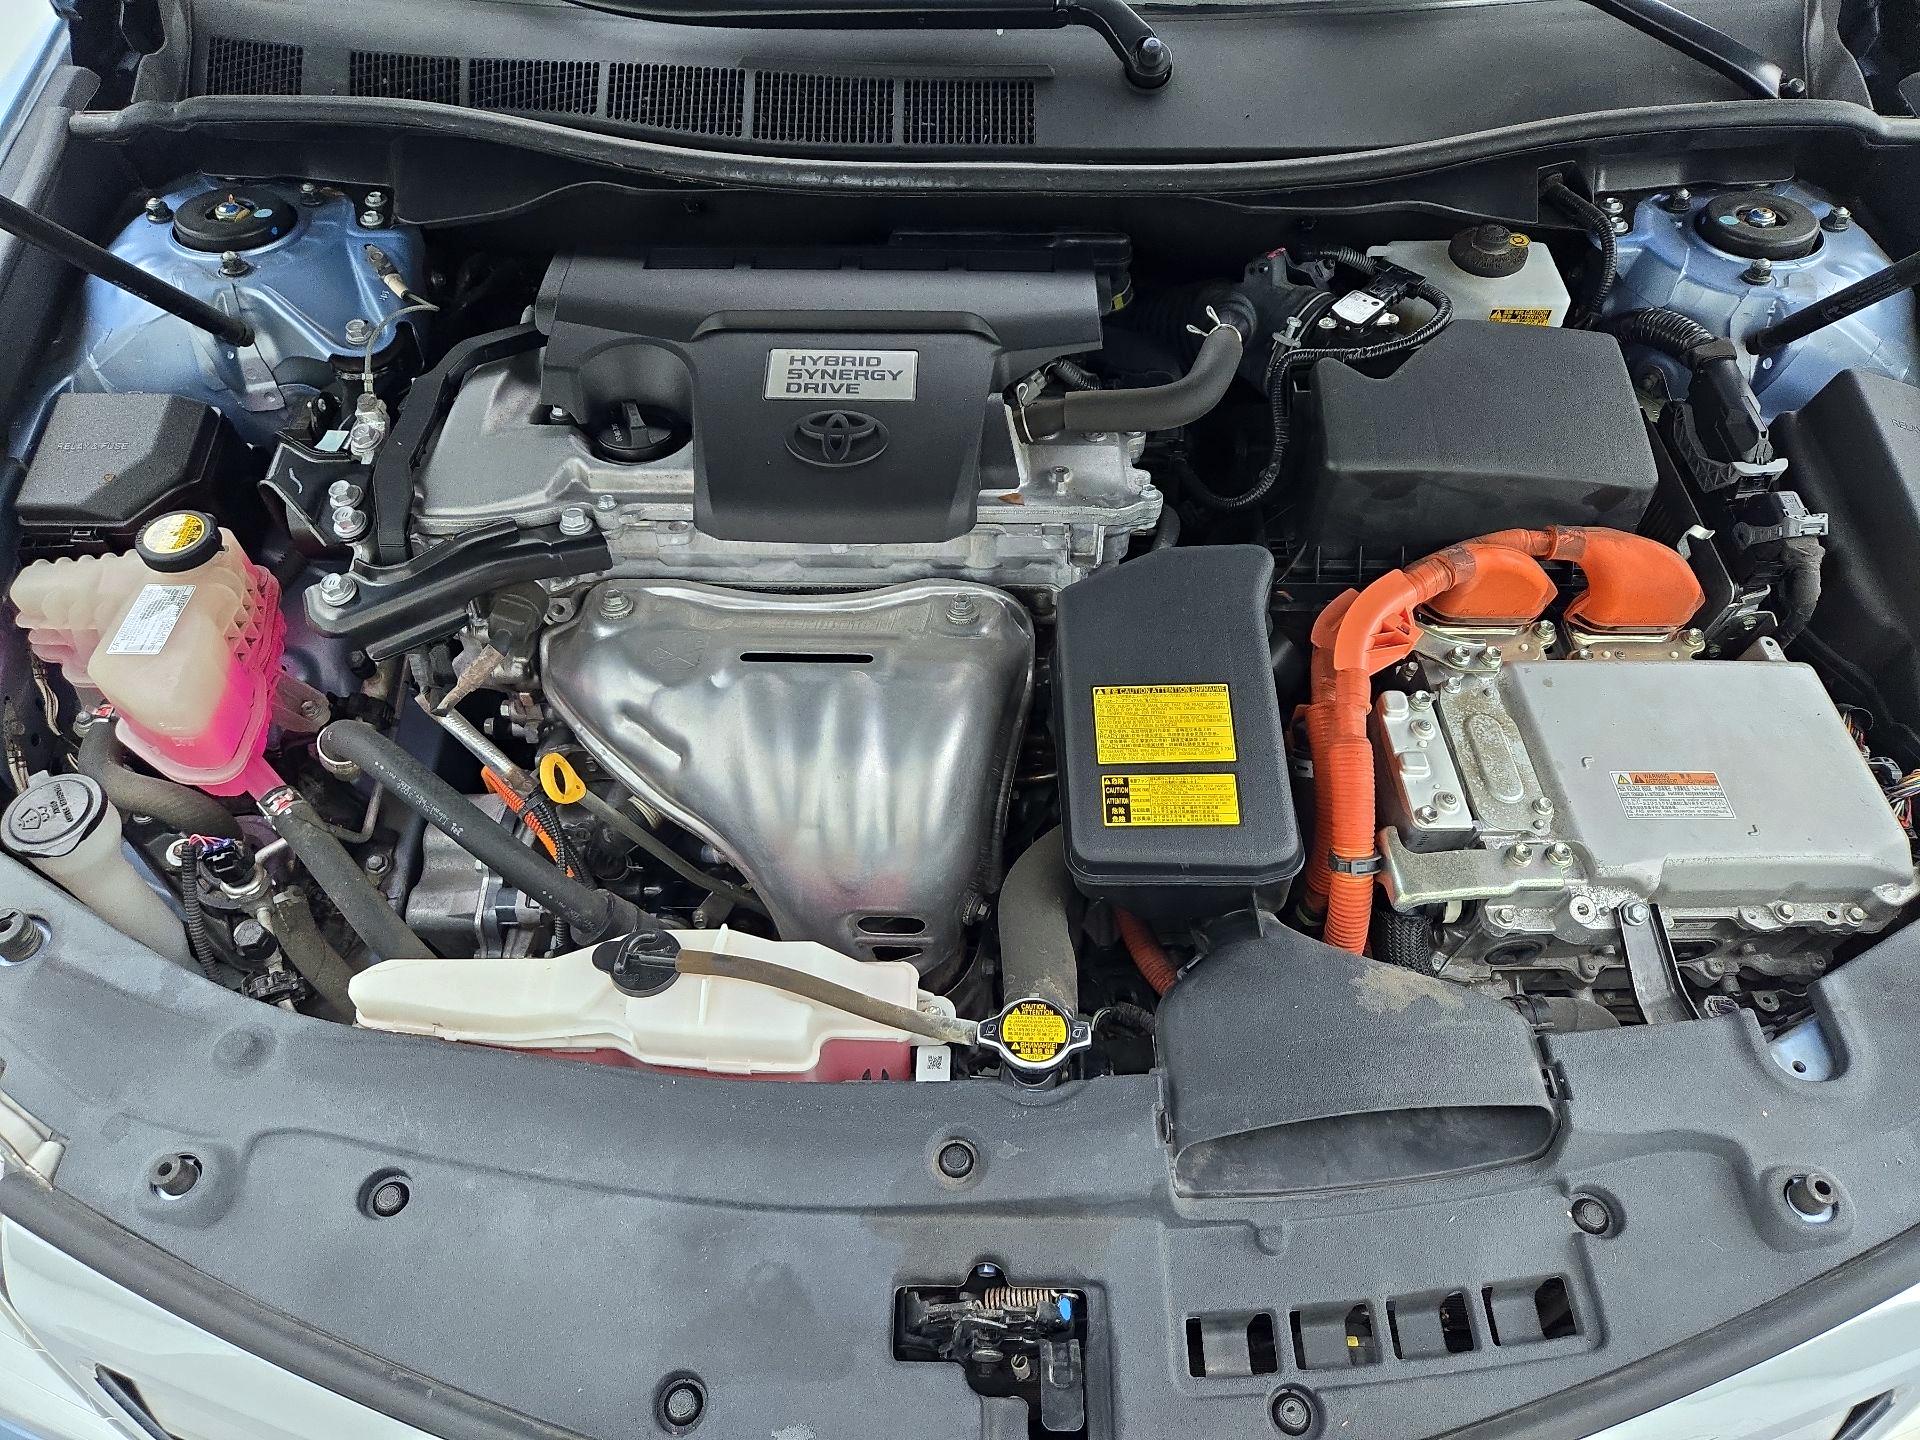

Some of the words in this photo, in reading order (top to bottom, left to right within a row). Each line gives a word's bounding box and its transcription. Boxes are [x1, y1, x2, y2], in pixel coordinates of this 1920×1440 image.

[789, 355, 882, 367] HYBRID
[787, 368, 904, 381] SYNERGY
[785, 382, 861, 394] DRIVE
[57, 442, 91, 451] RELAY
[91, 442, 99, 451] &
[101, 441, 130, 451] FUSE
[1119, 687, 1151, 695] CAUTION
[1151, 686, 1190, 694] ATTENTION
[1105, 786, 1129, 794] CAUTION
[1106, 797, 1130, 805] ATTENTION
